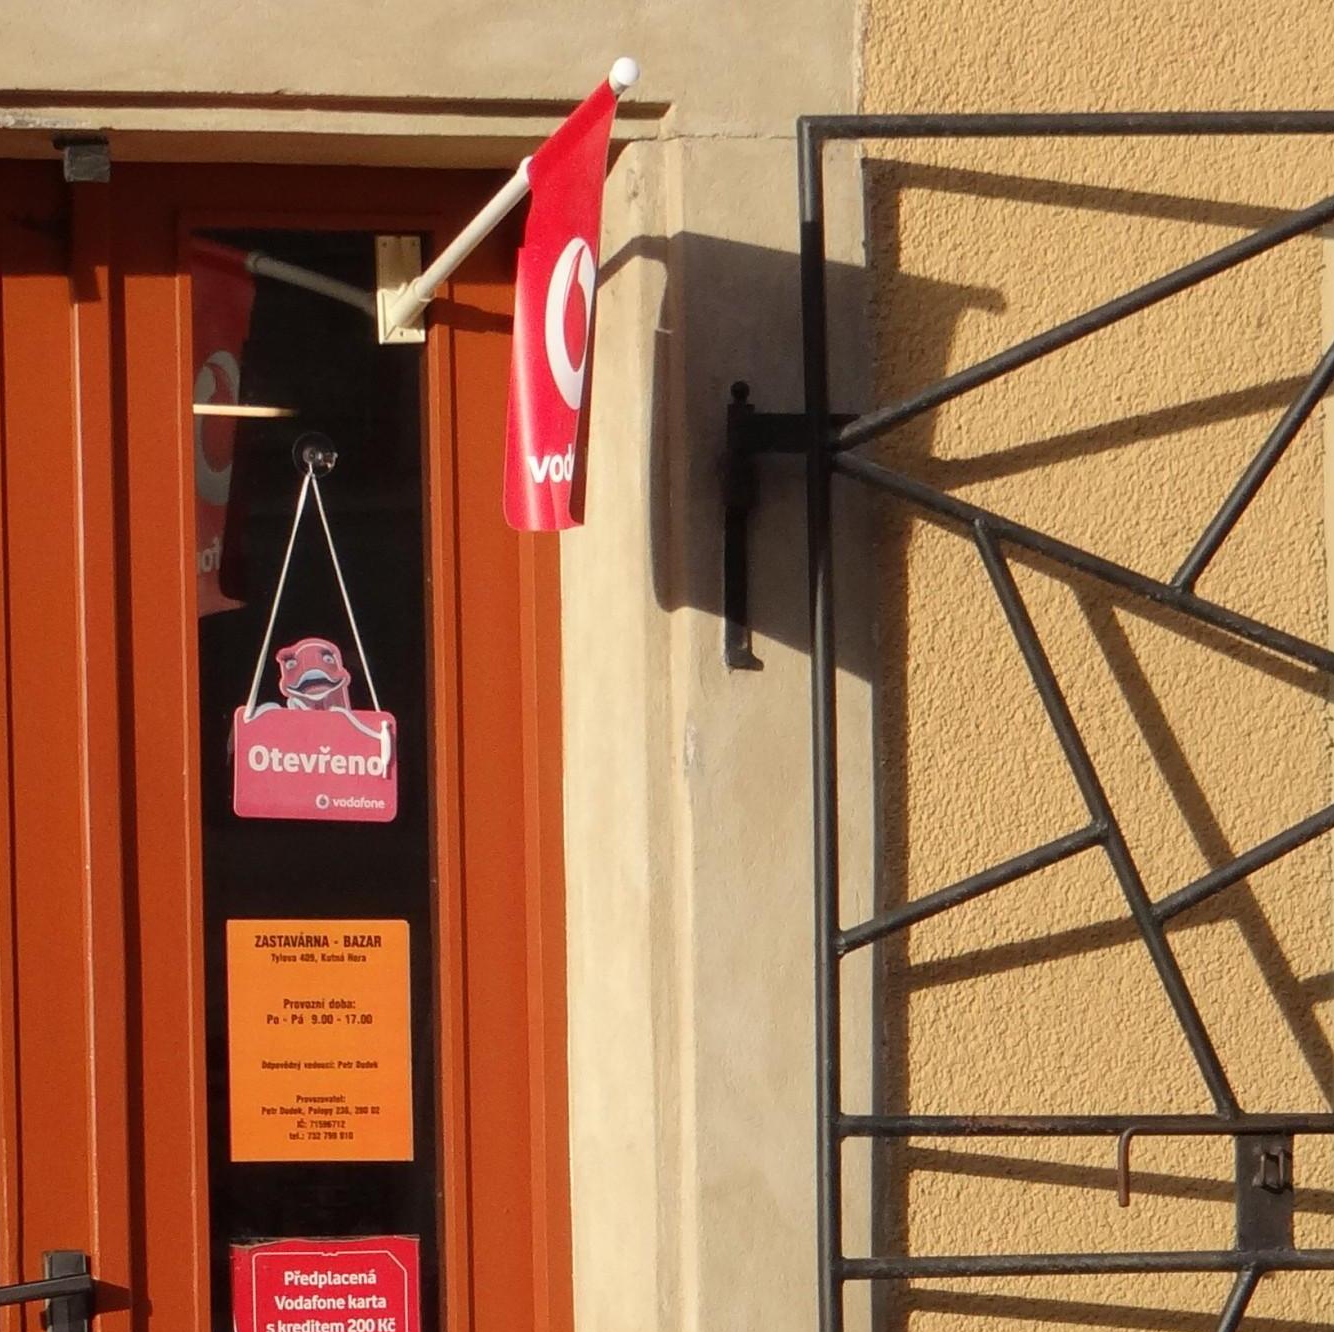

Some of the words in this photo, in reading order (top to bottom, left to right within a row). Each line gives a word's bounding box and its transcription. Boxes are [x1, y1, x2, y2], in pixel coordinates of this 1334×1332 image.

[248, 745, 385, 776] Otevřeno
[333, 796, 385, 809] vodafone
[255, 932, 329, 948] ZASTAVÁRNA
[343, 935, 382, 948] BAZAR
[283, 998, 325, 1010] Provozní
[328, 998, 356, 1010] doba:
[267, 1014, 279, 1025] Po
[291, 1013, 304, 1025] Pá
[311, 1014, 334, 1025] 9.00
[345, 1014, 373, 1025] 17.00
[283, 1269, 377, 1288] Předplacená
[274, 1294, 345, 1310] Vodafone
[347, 1294, 387, 1309] karta
[347, 1319, 375, 1332] 200
[378, 1317, 396, 1332] Kč
